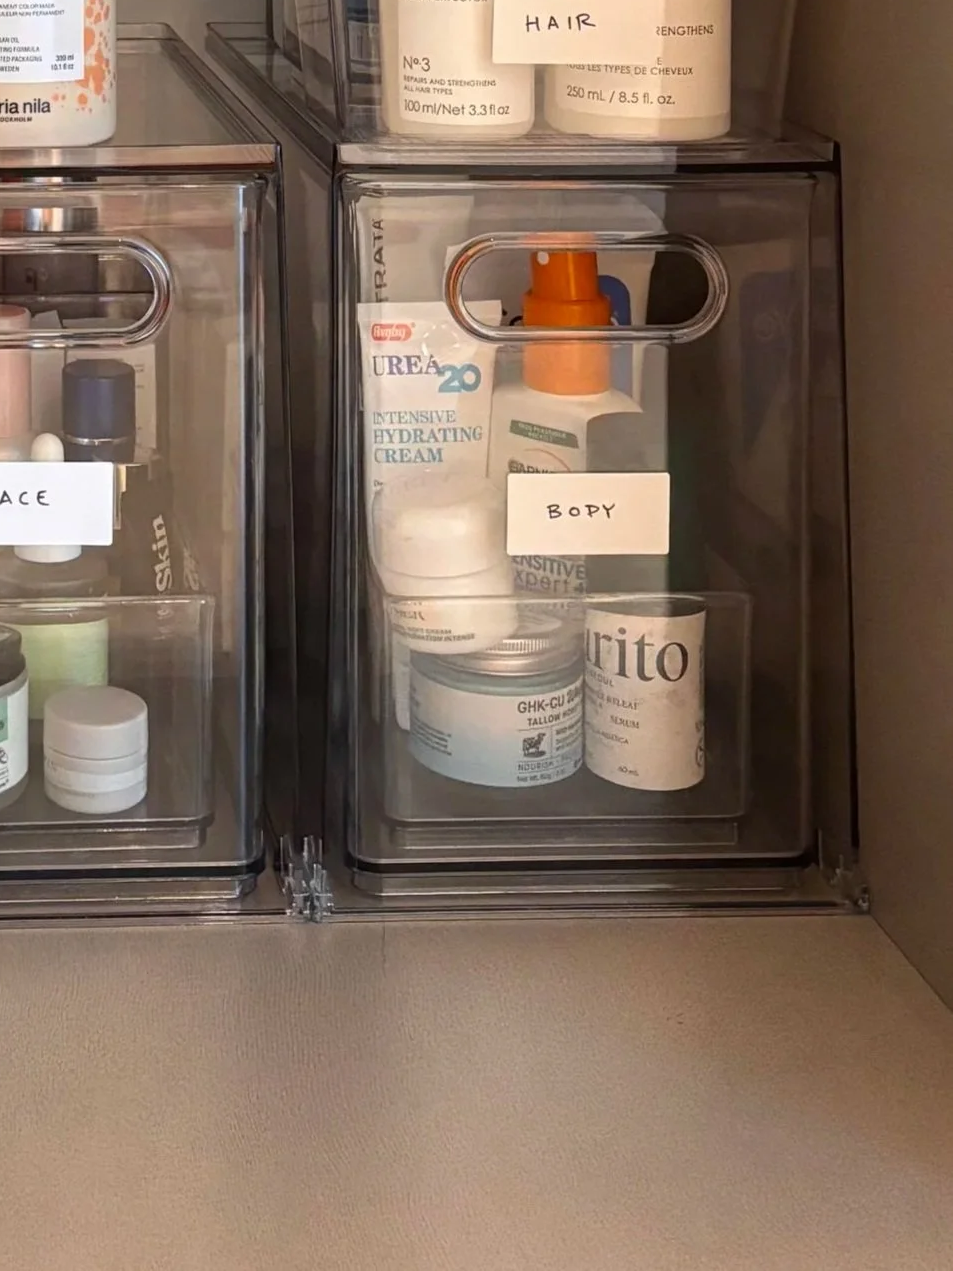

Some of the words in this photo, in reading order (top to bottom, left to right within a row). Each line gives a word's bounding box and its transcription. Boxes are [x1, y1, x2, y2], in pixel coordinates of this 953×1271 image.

[525, 13, 597, 33] HAIR
[604, 64, 631, 75] TYPES
[634, 66, 647, 75] DE
[650, 66, 694, 76] CHEVEUX
[429, 78, 446, 86] AND
[566, 85, 585, 98] 250
[587, 89, 606, 102] mL
[608, 90, 616, 104] /
[618, 91, 639, 104] 8.5
[657, 94, 676, 105] oz.
[23, 98, 51, 114] nila
[404, 99, 421, 112] 100
[468, 104, 488, 116] 3.3
[497, 105, 510, 115] oz
[372, 218, 388, 303] TRATA
[373, 354, 441, 376] UREA
[437, 362, 482, 393] 20
[373, 410, 456, 425] INTENSIVE
[374, 425, 483, 445] HYDRATING
[374, 447, 444, 464] CREAM
[546, 503, 616, 520] BODY
[152, 514, 173, 592] Skin
[511, 555, 586, 580] ENSITIVE
[514, 568, 570, 593] xpert
[517, 694, 565, 714] GHK-CU
[527, 713, 560, 726] TALLOW
